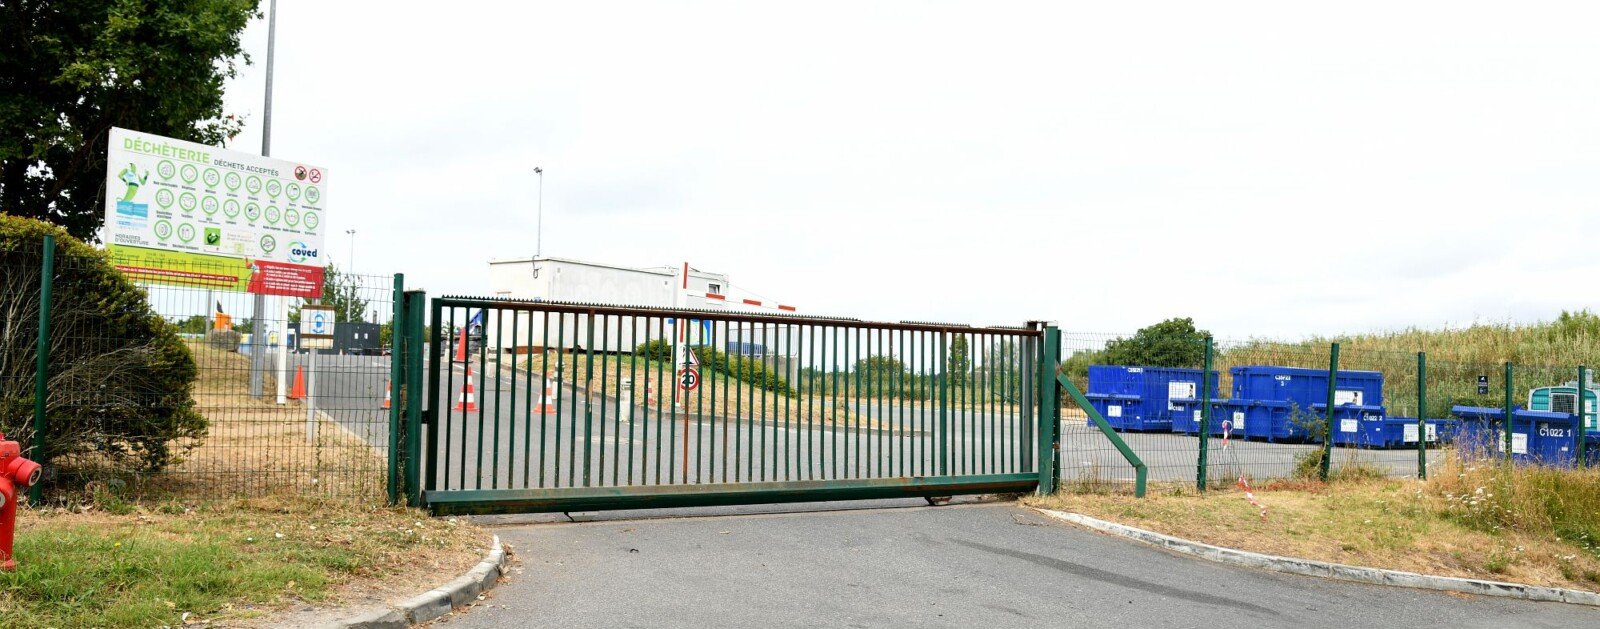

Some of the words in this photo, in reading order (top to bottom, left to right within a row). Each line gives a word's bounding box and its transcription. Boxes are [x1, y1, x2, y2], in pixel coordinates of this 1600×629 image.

[124, 137, 210, 163] DÉCHÈTERIE
[214, 159, 244, 171] DÉCHETS
[246, 165, 279, 177] ACCEPTÉS
[292, 248, 318, 258] coved
[682, 374, 695, 385] 20
[1540, 428, 1563, 437] C1022
[1567, 429, 1571, 437] 1
